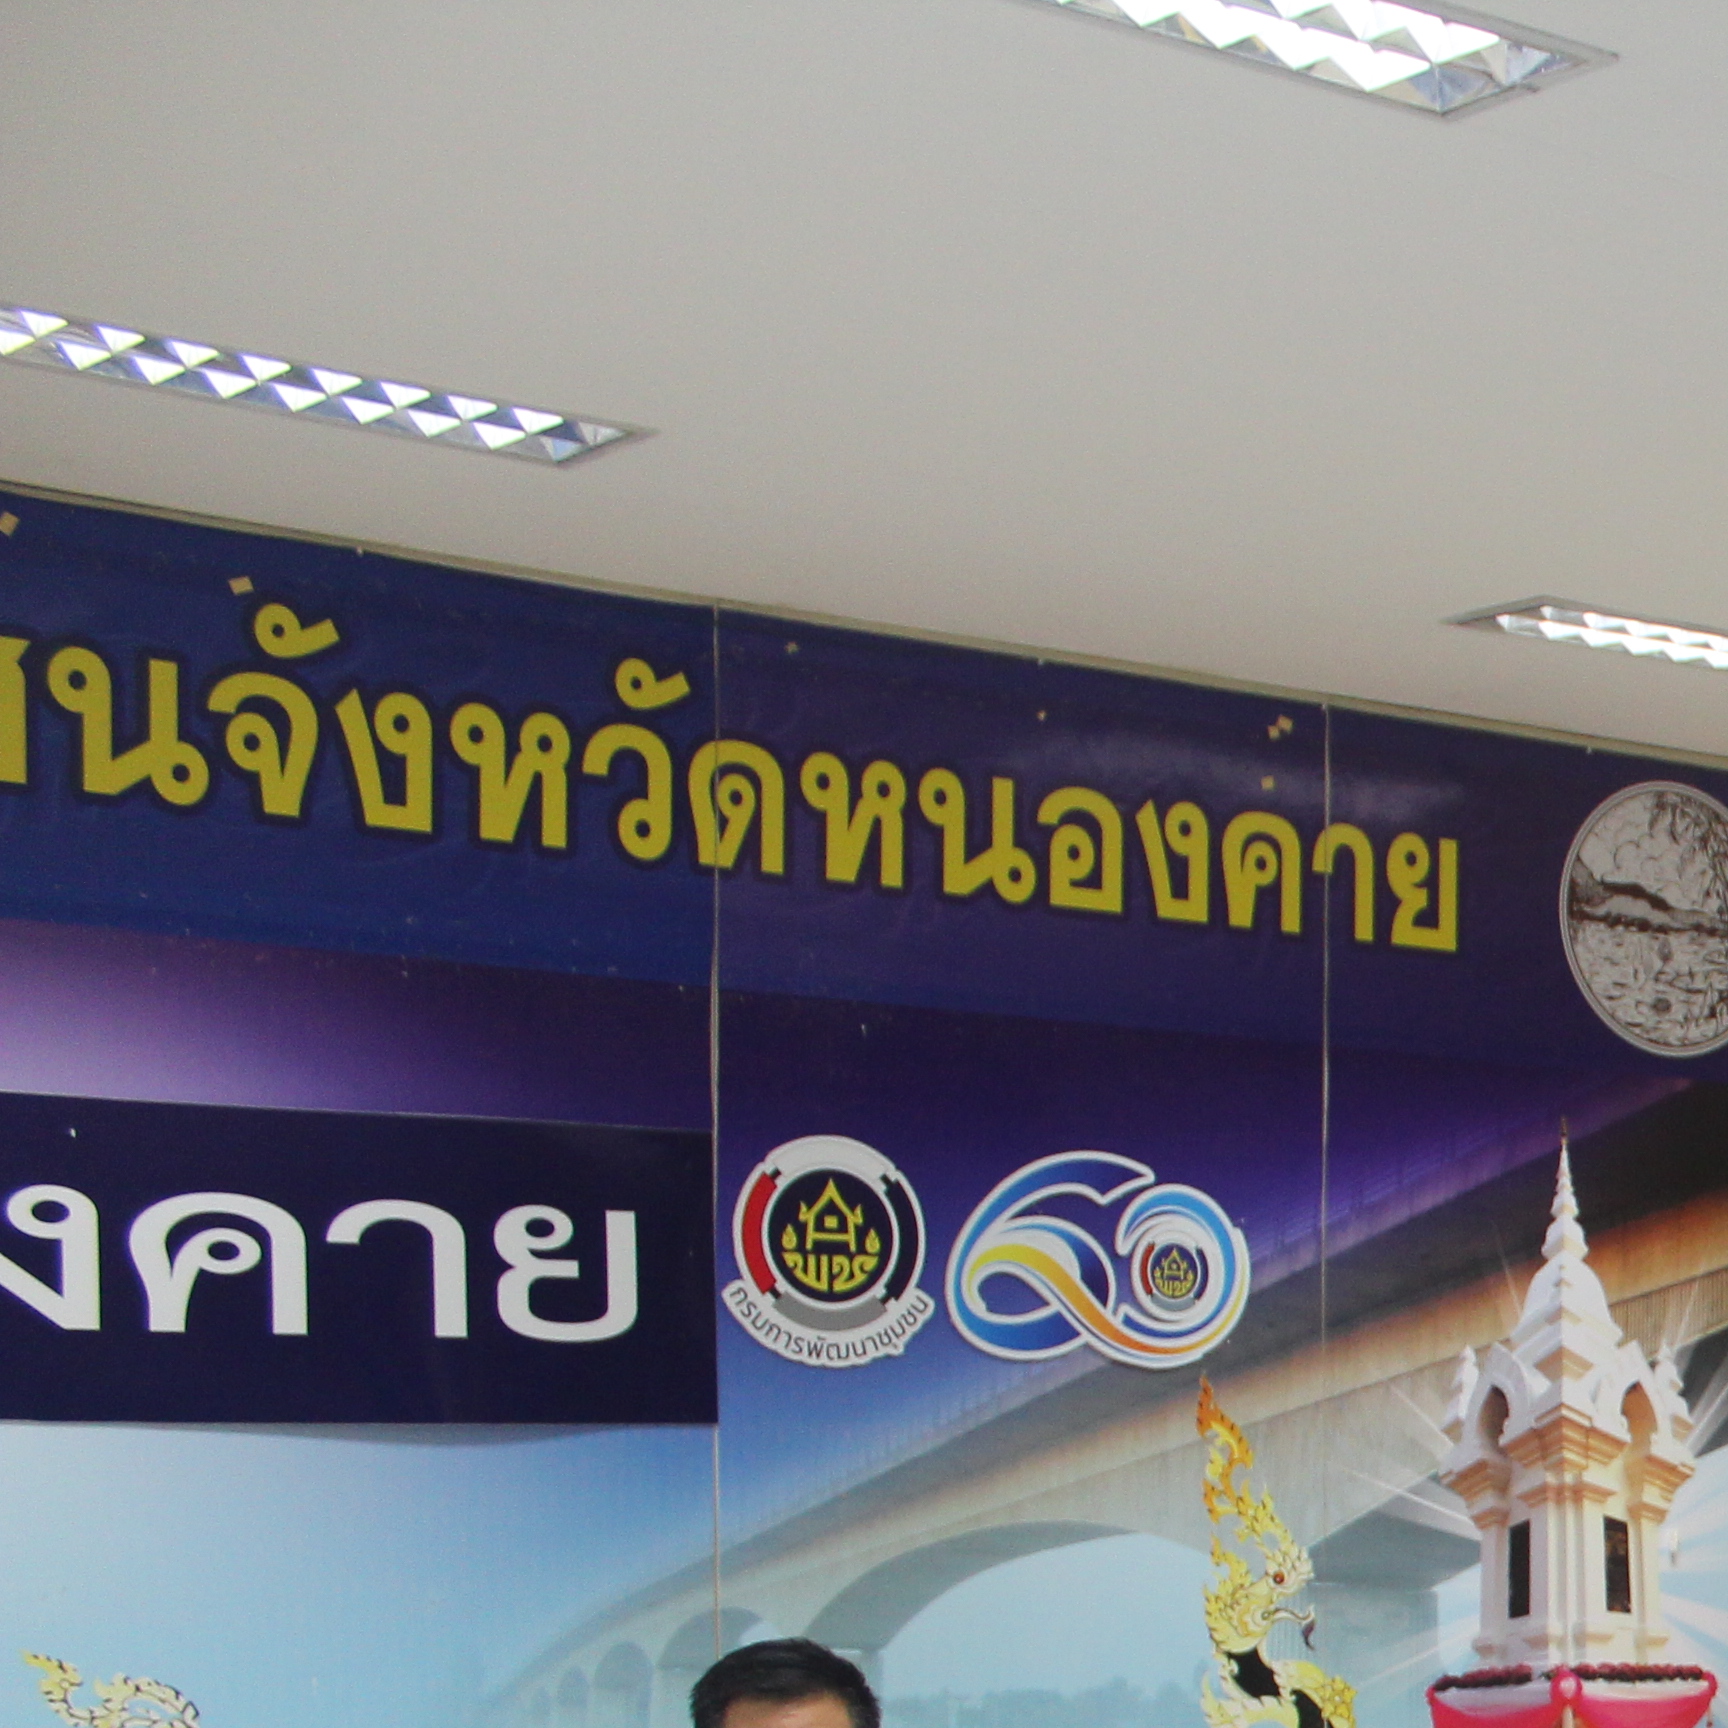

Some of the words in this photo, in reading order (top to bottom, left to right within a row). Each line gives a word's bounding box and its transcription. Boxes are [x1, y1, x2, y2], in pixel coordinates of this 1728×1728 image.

[729, 1286, 930, 1362] กรมการพัฒนาชุมชน
